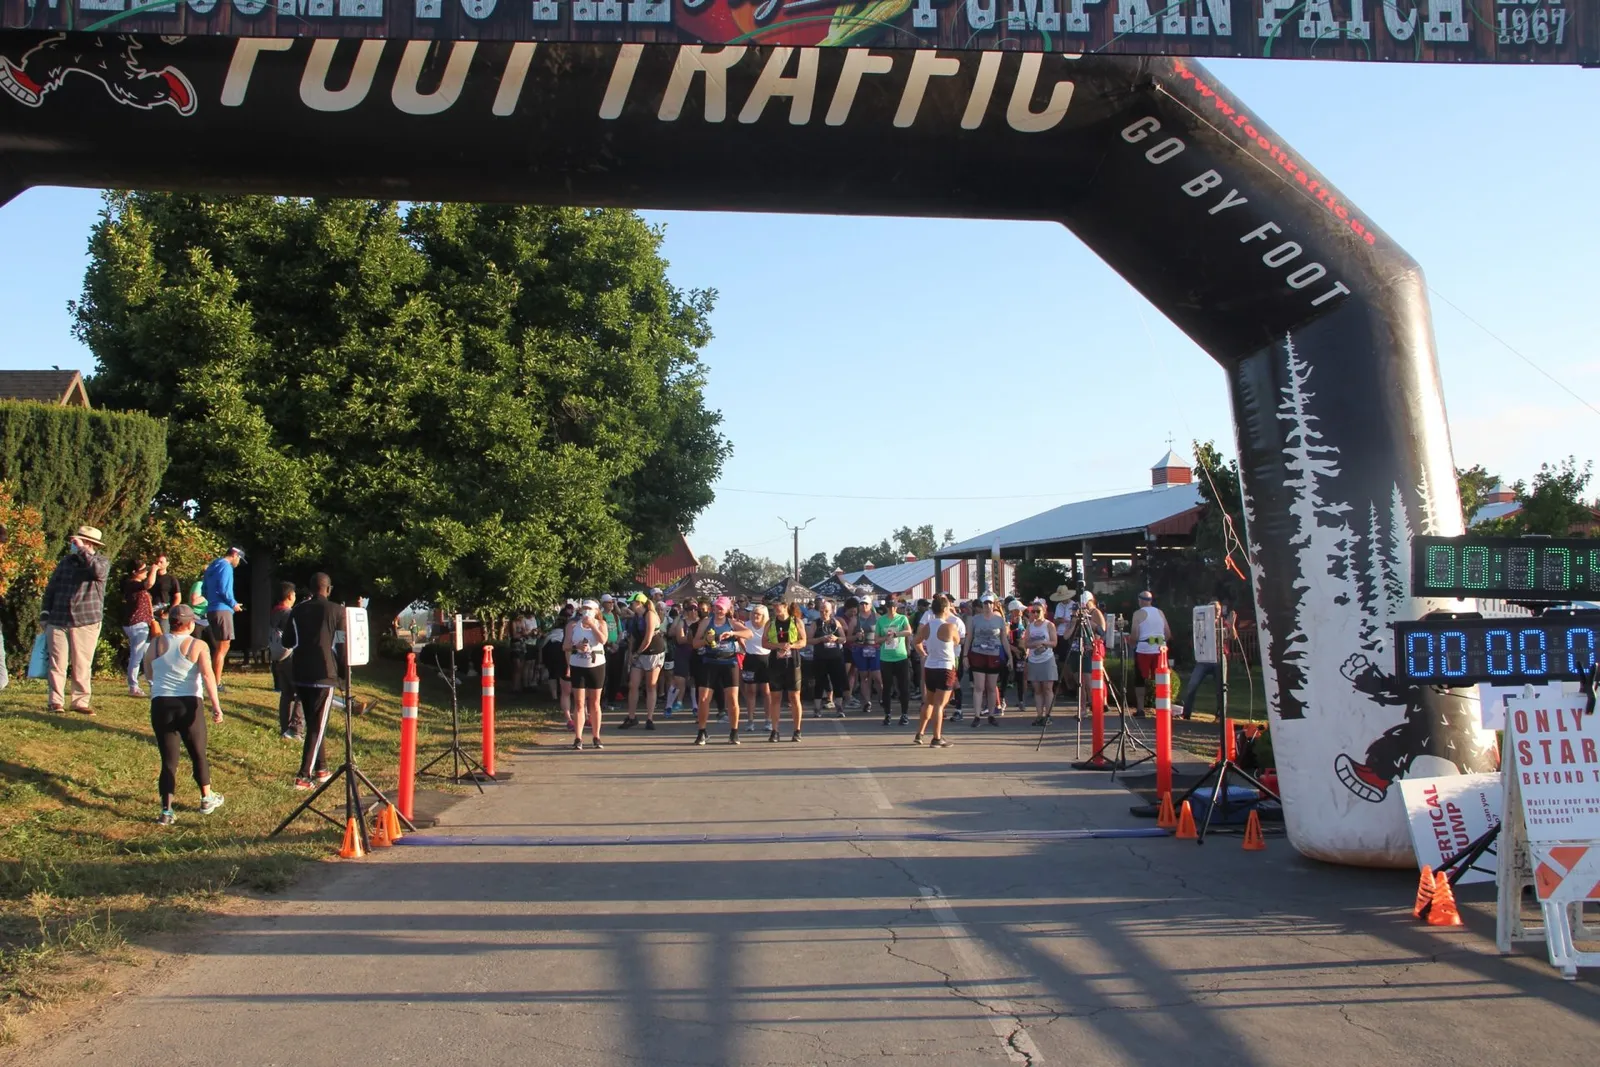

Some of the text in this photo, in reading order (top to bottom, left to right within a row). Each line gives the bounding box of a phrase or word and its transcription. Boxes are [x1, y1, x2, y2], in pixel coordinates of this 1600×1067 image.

[1497, 8, 1567, 45] 1967
[598, 43, 1083, 133] TRAFFIC
[1120, 115, 1351, 307] GO BY FOOT
[1514, 708, 1583, 734] ONLY
[1517, 738, 1598, 766] STAR
[1522, 770, 1584, 785] BEYOND
[1480, 792, 1489, 808] you
[1548, 798, 1560, 806] for
[1484, 808, 1492, 823] can
